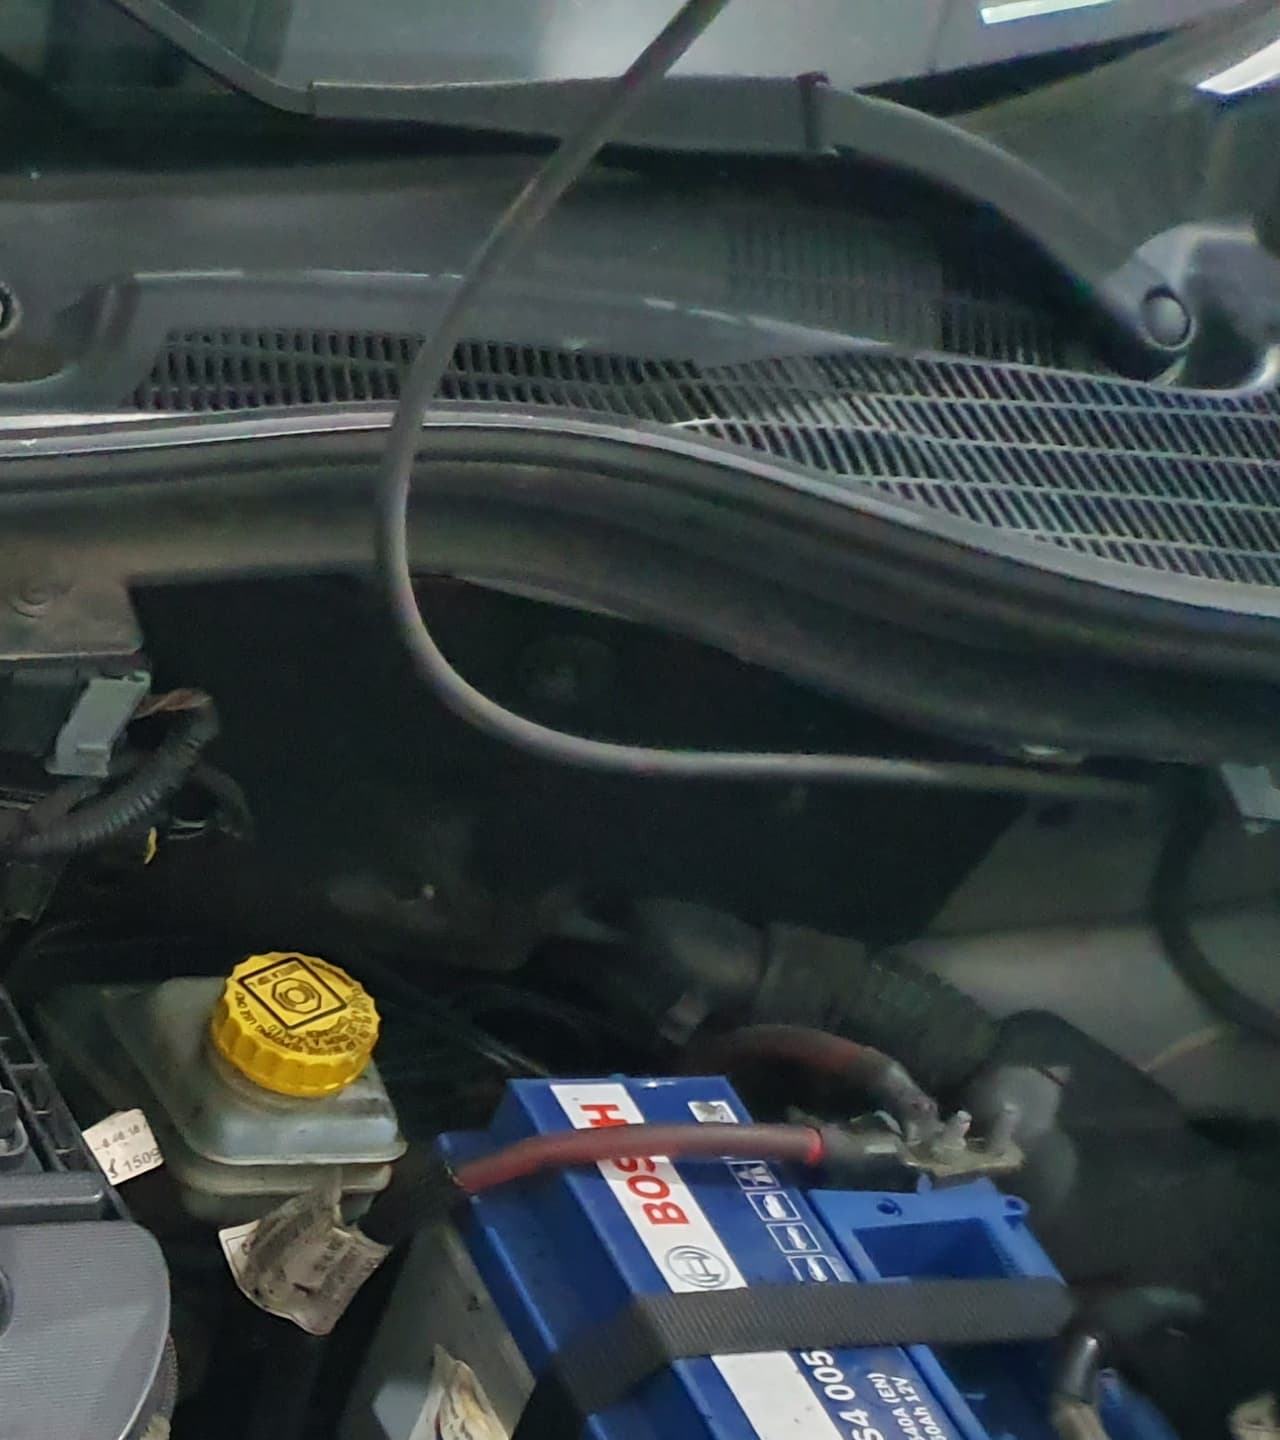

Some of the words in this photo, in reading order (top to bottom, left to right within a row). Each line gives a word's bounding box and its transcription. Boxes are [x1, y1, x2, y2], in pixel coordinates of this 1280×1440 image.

[581, 1104, 689, 1225] BOSH
[800, 1350, 856, 1401] 005
[866, 1372, 901, 1403] (EN)
[891, 1376, 921, 1402] 12V
